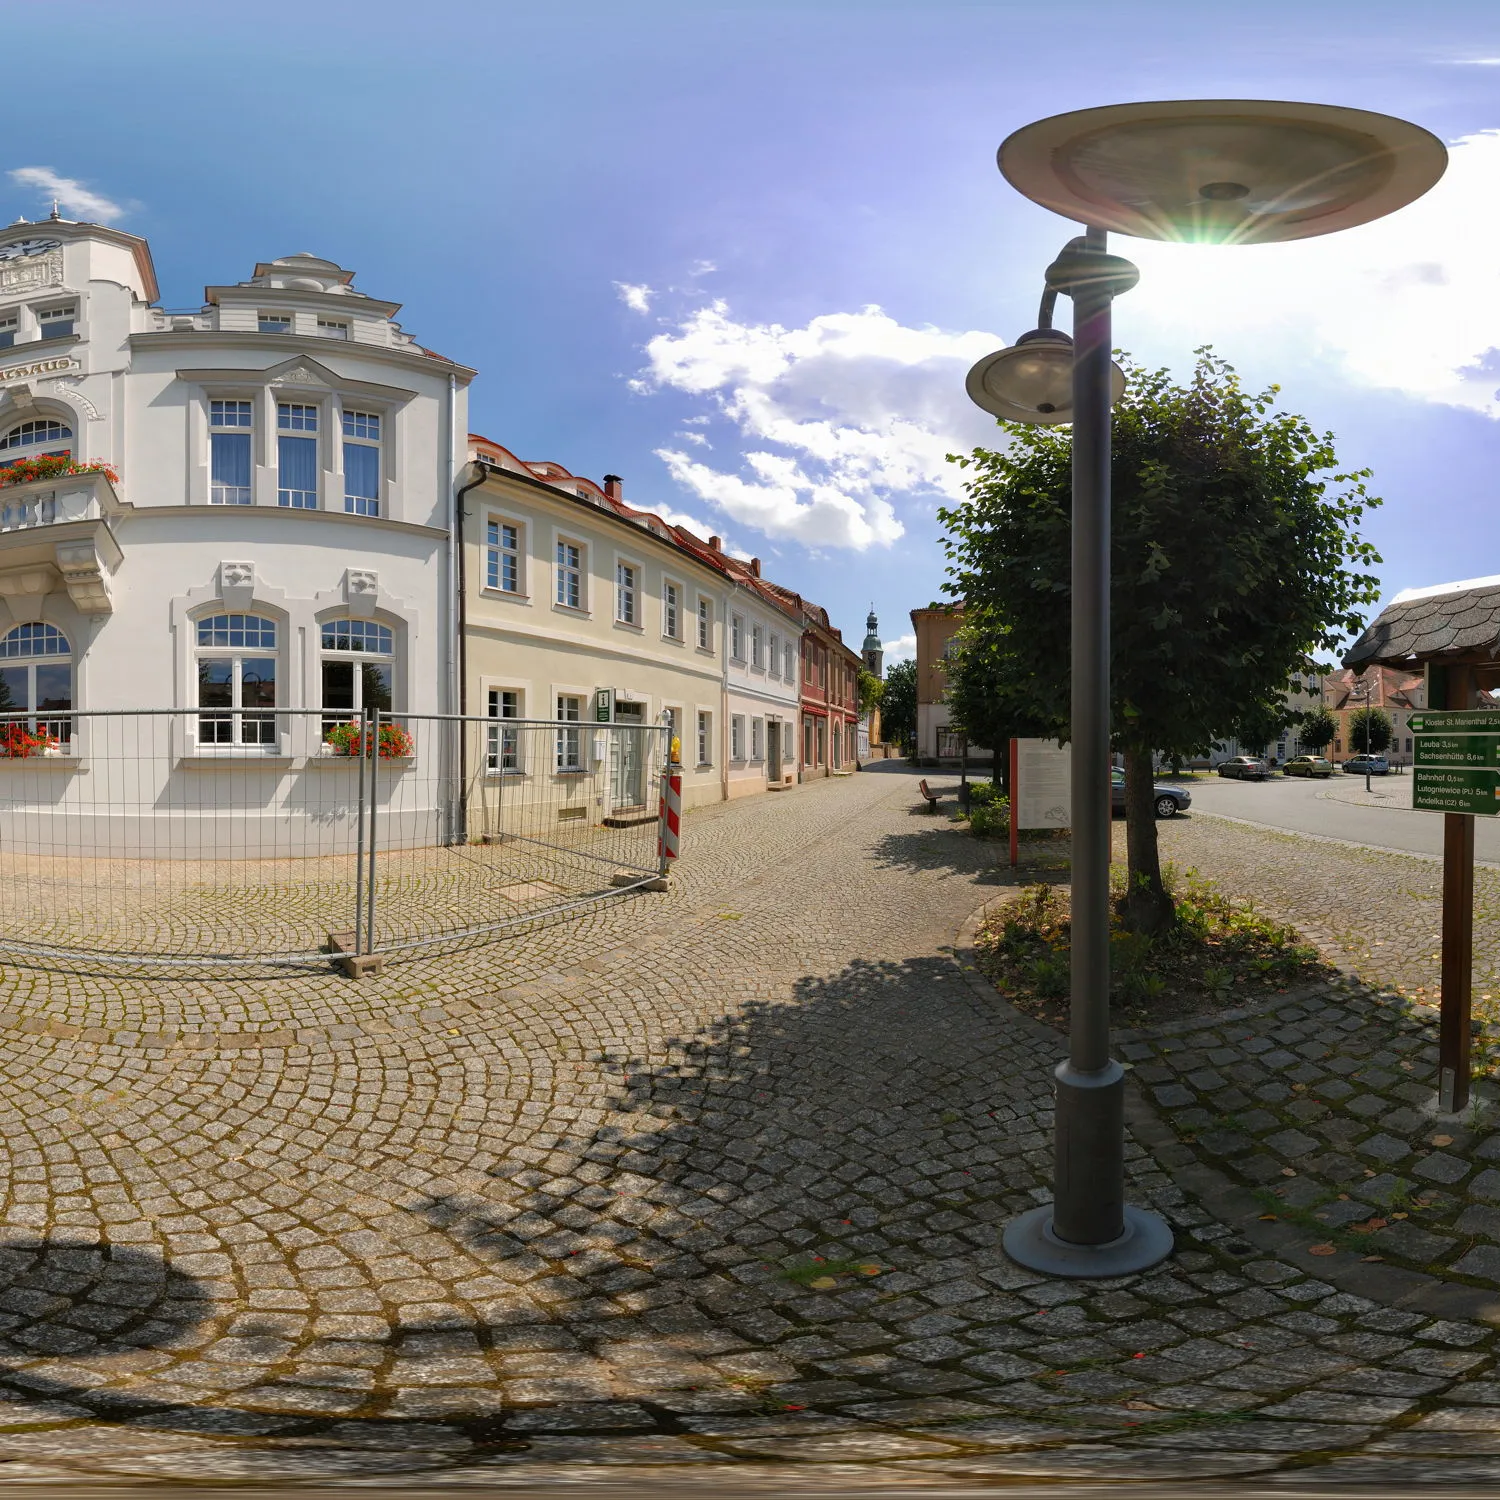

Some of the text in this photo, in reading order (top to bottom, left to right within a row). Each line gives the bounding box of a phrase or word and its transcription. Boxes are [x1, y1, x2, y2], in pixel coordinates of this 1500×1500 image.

[1424, 718, 1445, 726] Kloster
[1455, 717, 1487, 726] Marienthal
[1420, 740, 1440, 748] Leuba
[1419, 752, 1465, 760] Sachsenhütte
[1417, 773, 1445, 782] Bahnhof
[1417, 785, 1461, 794] Lutogniewice
